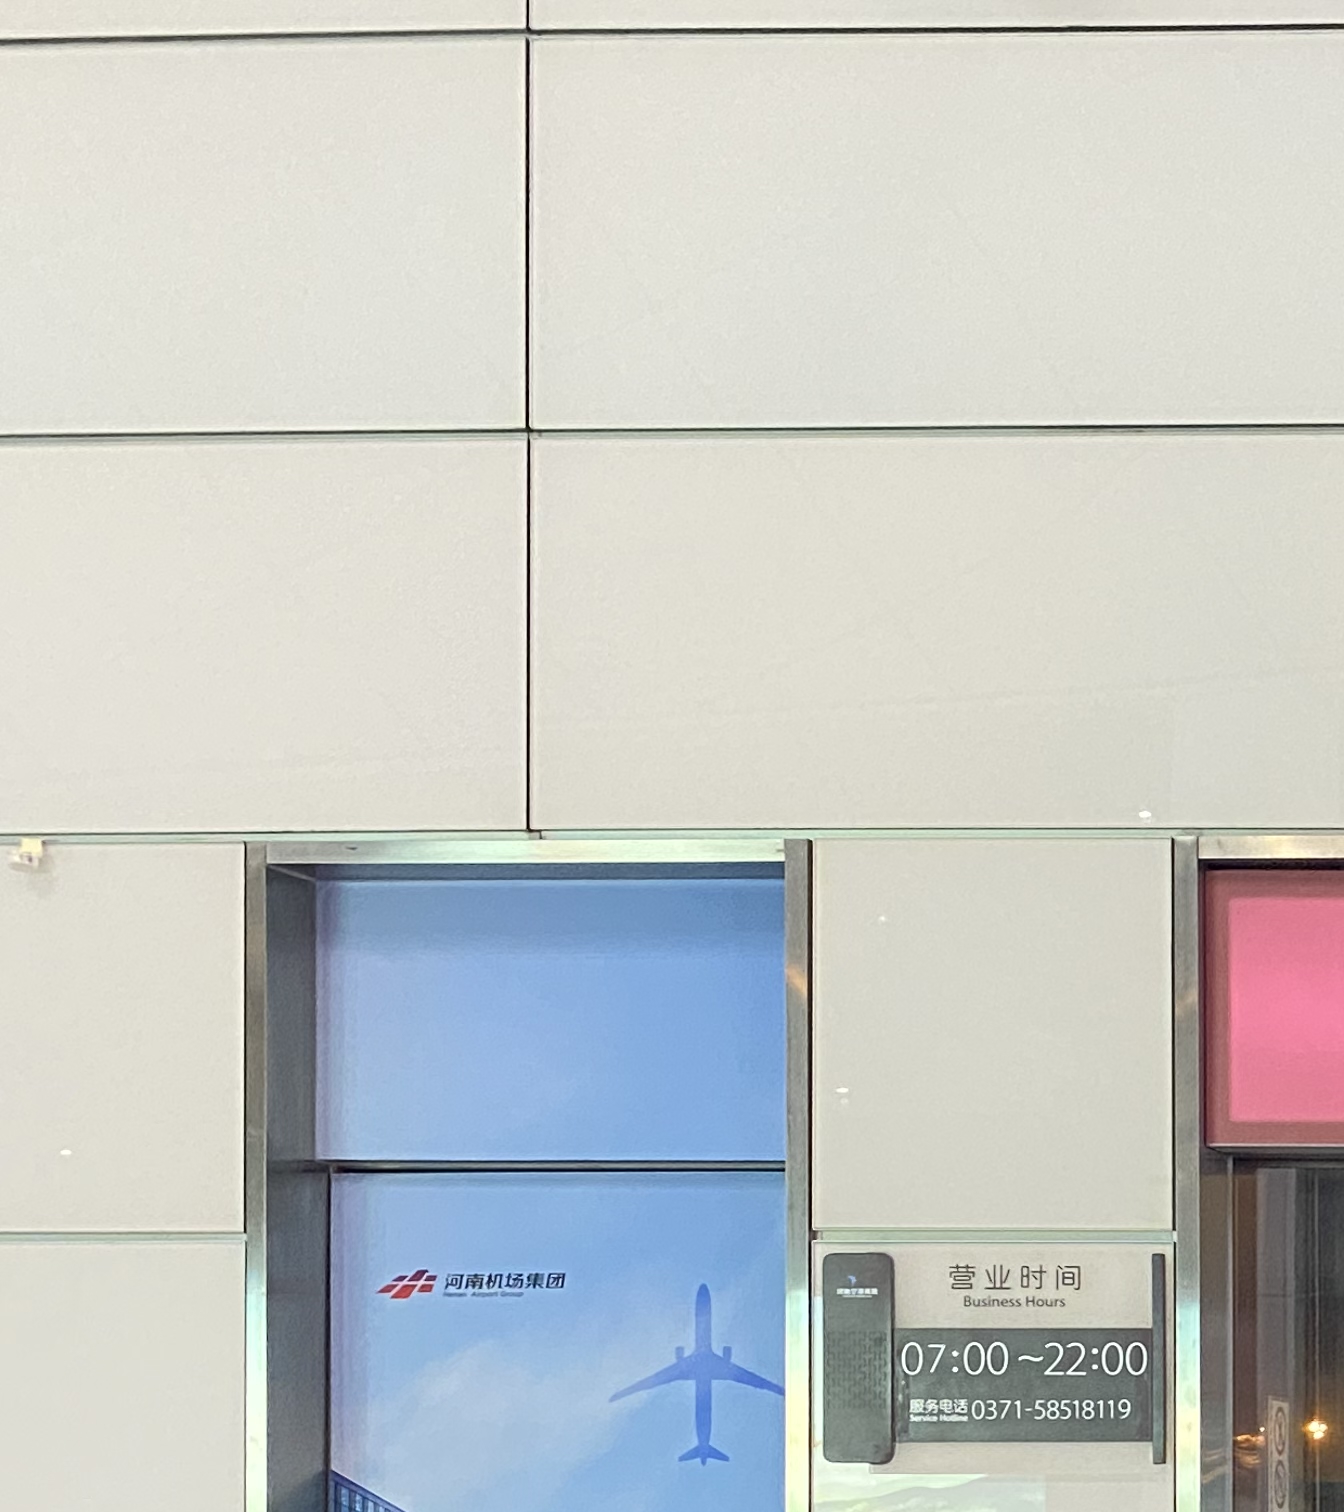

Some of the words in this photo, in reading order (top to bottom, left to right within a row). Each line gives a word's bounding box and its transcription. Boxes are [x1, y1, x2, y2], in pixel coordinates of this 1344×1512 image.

[443, 1272, 567, 1291] 河南机场集团
[948, 1263, 1082, 1291] 营业时间
[963, 1294, 1022, 1308] Business
[1025, 1295, 1067, 1308] Hours
[909, 1398, 968, 1414] 服务电话
[971, 1399, 1131, 1420] 0371-58518119
